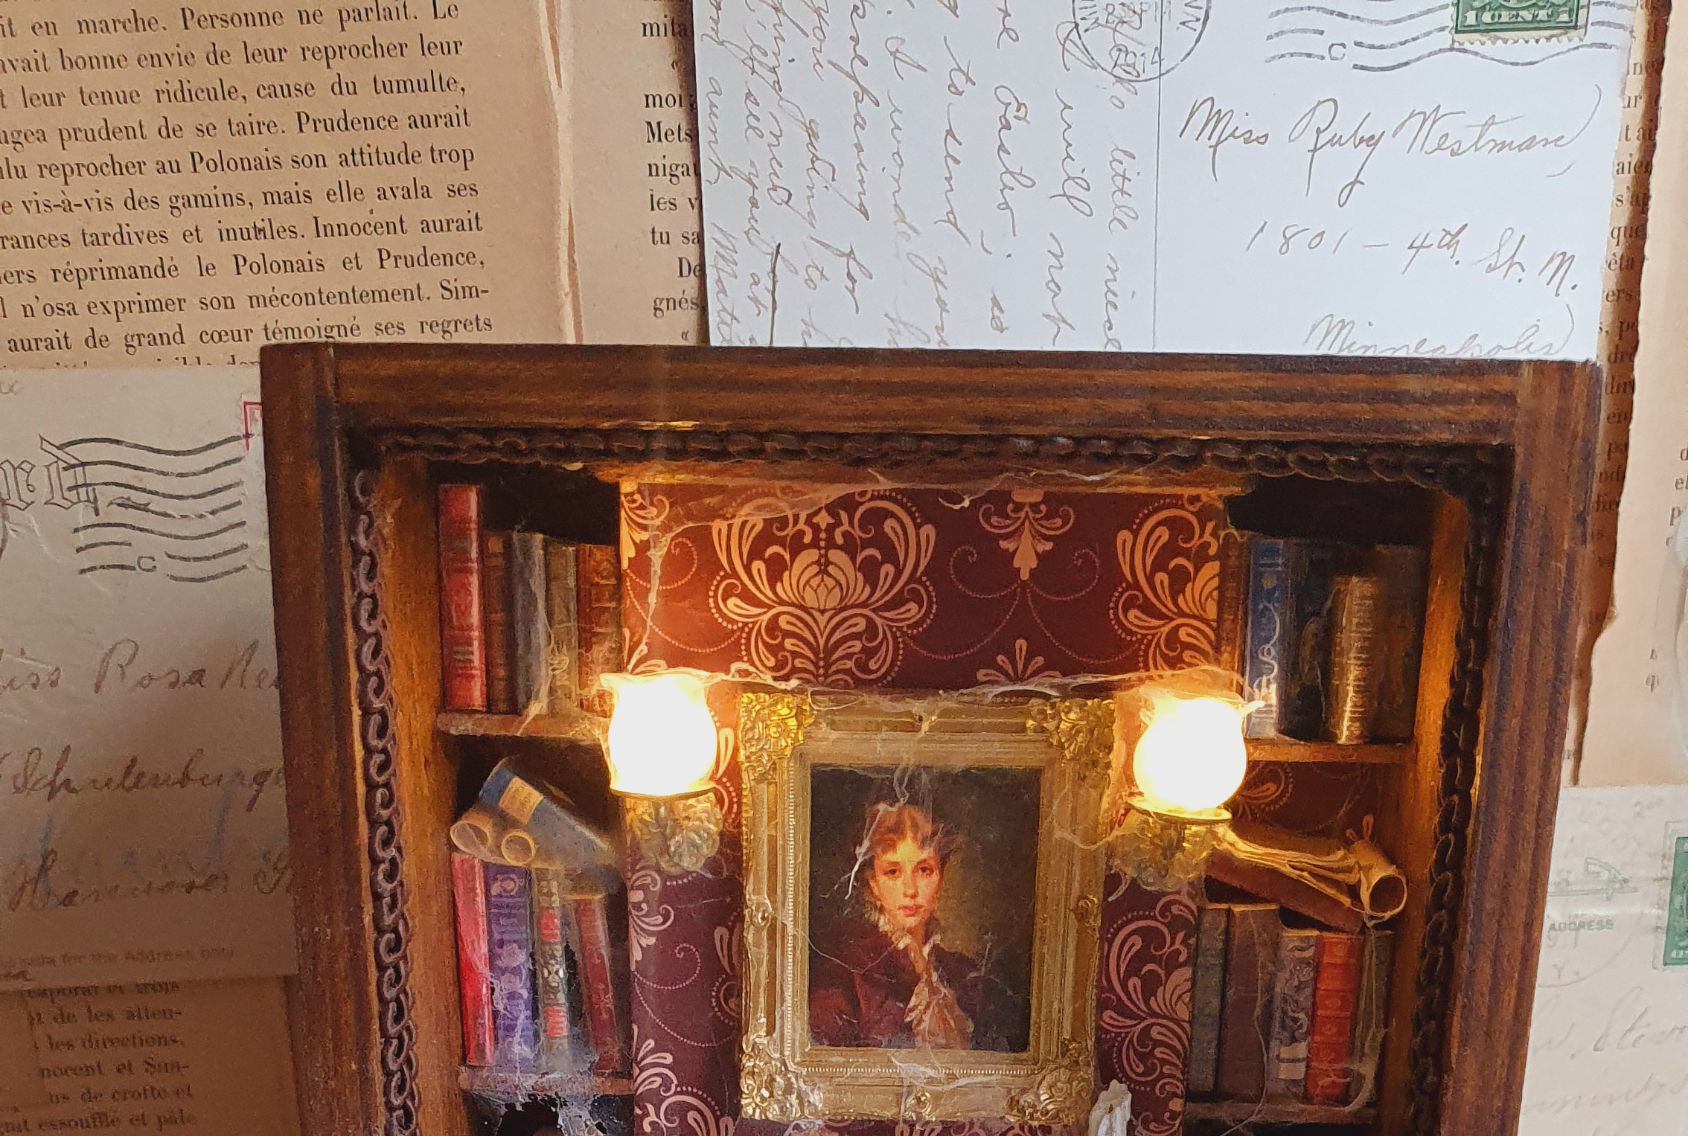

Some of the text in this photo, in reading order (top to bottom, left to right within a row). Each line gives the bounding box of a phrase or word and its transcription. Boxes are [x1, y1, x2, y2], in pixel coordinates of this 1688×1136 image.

[30, 20, 59, 37] en
[76, 8, 168, 35] marche.
[179, 6, 285, 31] Personne
[296, 8, 324, 26] ne
[337, 0, 418, 33] parlait.
[431, 0, 459, 20] Le
[57, 46, 129, 71] bonne
[136, 42, 197, 69] envie
[205, 41, 232, 67] de
[241, 39, 289, 65] leur
[299, 34, 409, 70] reprocher
[418, 32, 463, 58] leur
[943, 36, 974, 96] to
[20, 68, 466, 109] leur tenue ridicule, cause du tumulte,
[57, 116, 148, 152] prudent
[157, 115, 184, 140] de
[194, 121, 218, 139] se
[227, 112, 286, 138] taire.
[295, 107, 400, 134] Prudence
[407, 103, 472, 130] aurait
[36, 152, 148, 187] reprocher
[155, 158, 183, 175] au
[189, 146, 284, 174] Polonais
[290, 153, 328, 170] son
[338, 140, 423, 168] attitude
[429, 143, 475, 172] trop
[933, 103, 969, 246] send
[1048, 89, 1092, 217] will
[1178, 97, 1270, 182] Miss
[1287, 98, 1387, 207] Ruby
[20, 176, 479, 219] vis-à-vis des gamins, mais elle avala ses
[1107, 145, 1138, 234] little
[80, 222, 170, 248] tardives
[181, 223, 204, 244] et
[217, 217, 306, 243] inutiles.
[312, 207, 409, 239] Innocent
[419, 209, 484, 234] aurait
[1246, 220, 1349, 256] 1801
[50, 255, 180, 291] réprimandé
[195, 254, 217, 278] le
[231, 249, 326, 276] Polonais
[341, 251, 364, 272] et
[376, 244, 485, 270] Prudence,
[804, 261, 827, 290] to
[809, 245, 872, 314] for
[1041, 233, 1074, 347] not
[20, 277, 490, 324] n'osa exprimer son mécontentement. Sim-
[6, 313, 493, 357] aurait de grand cœur témoigné ses regrets
[93, 637, 208, 694] Rosa
[1547, 918, 1615, 933] ADDRESS
